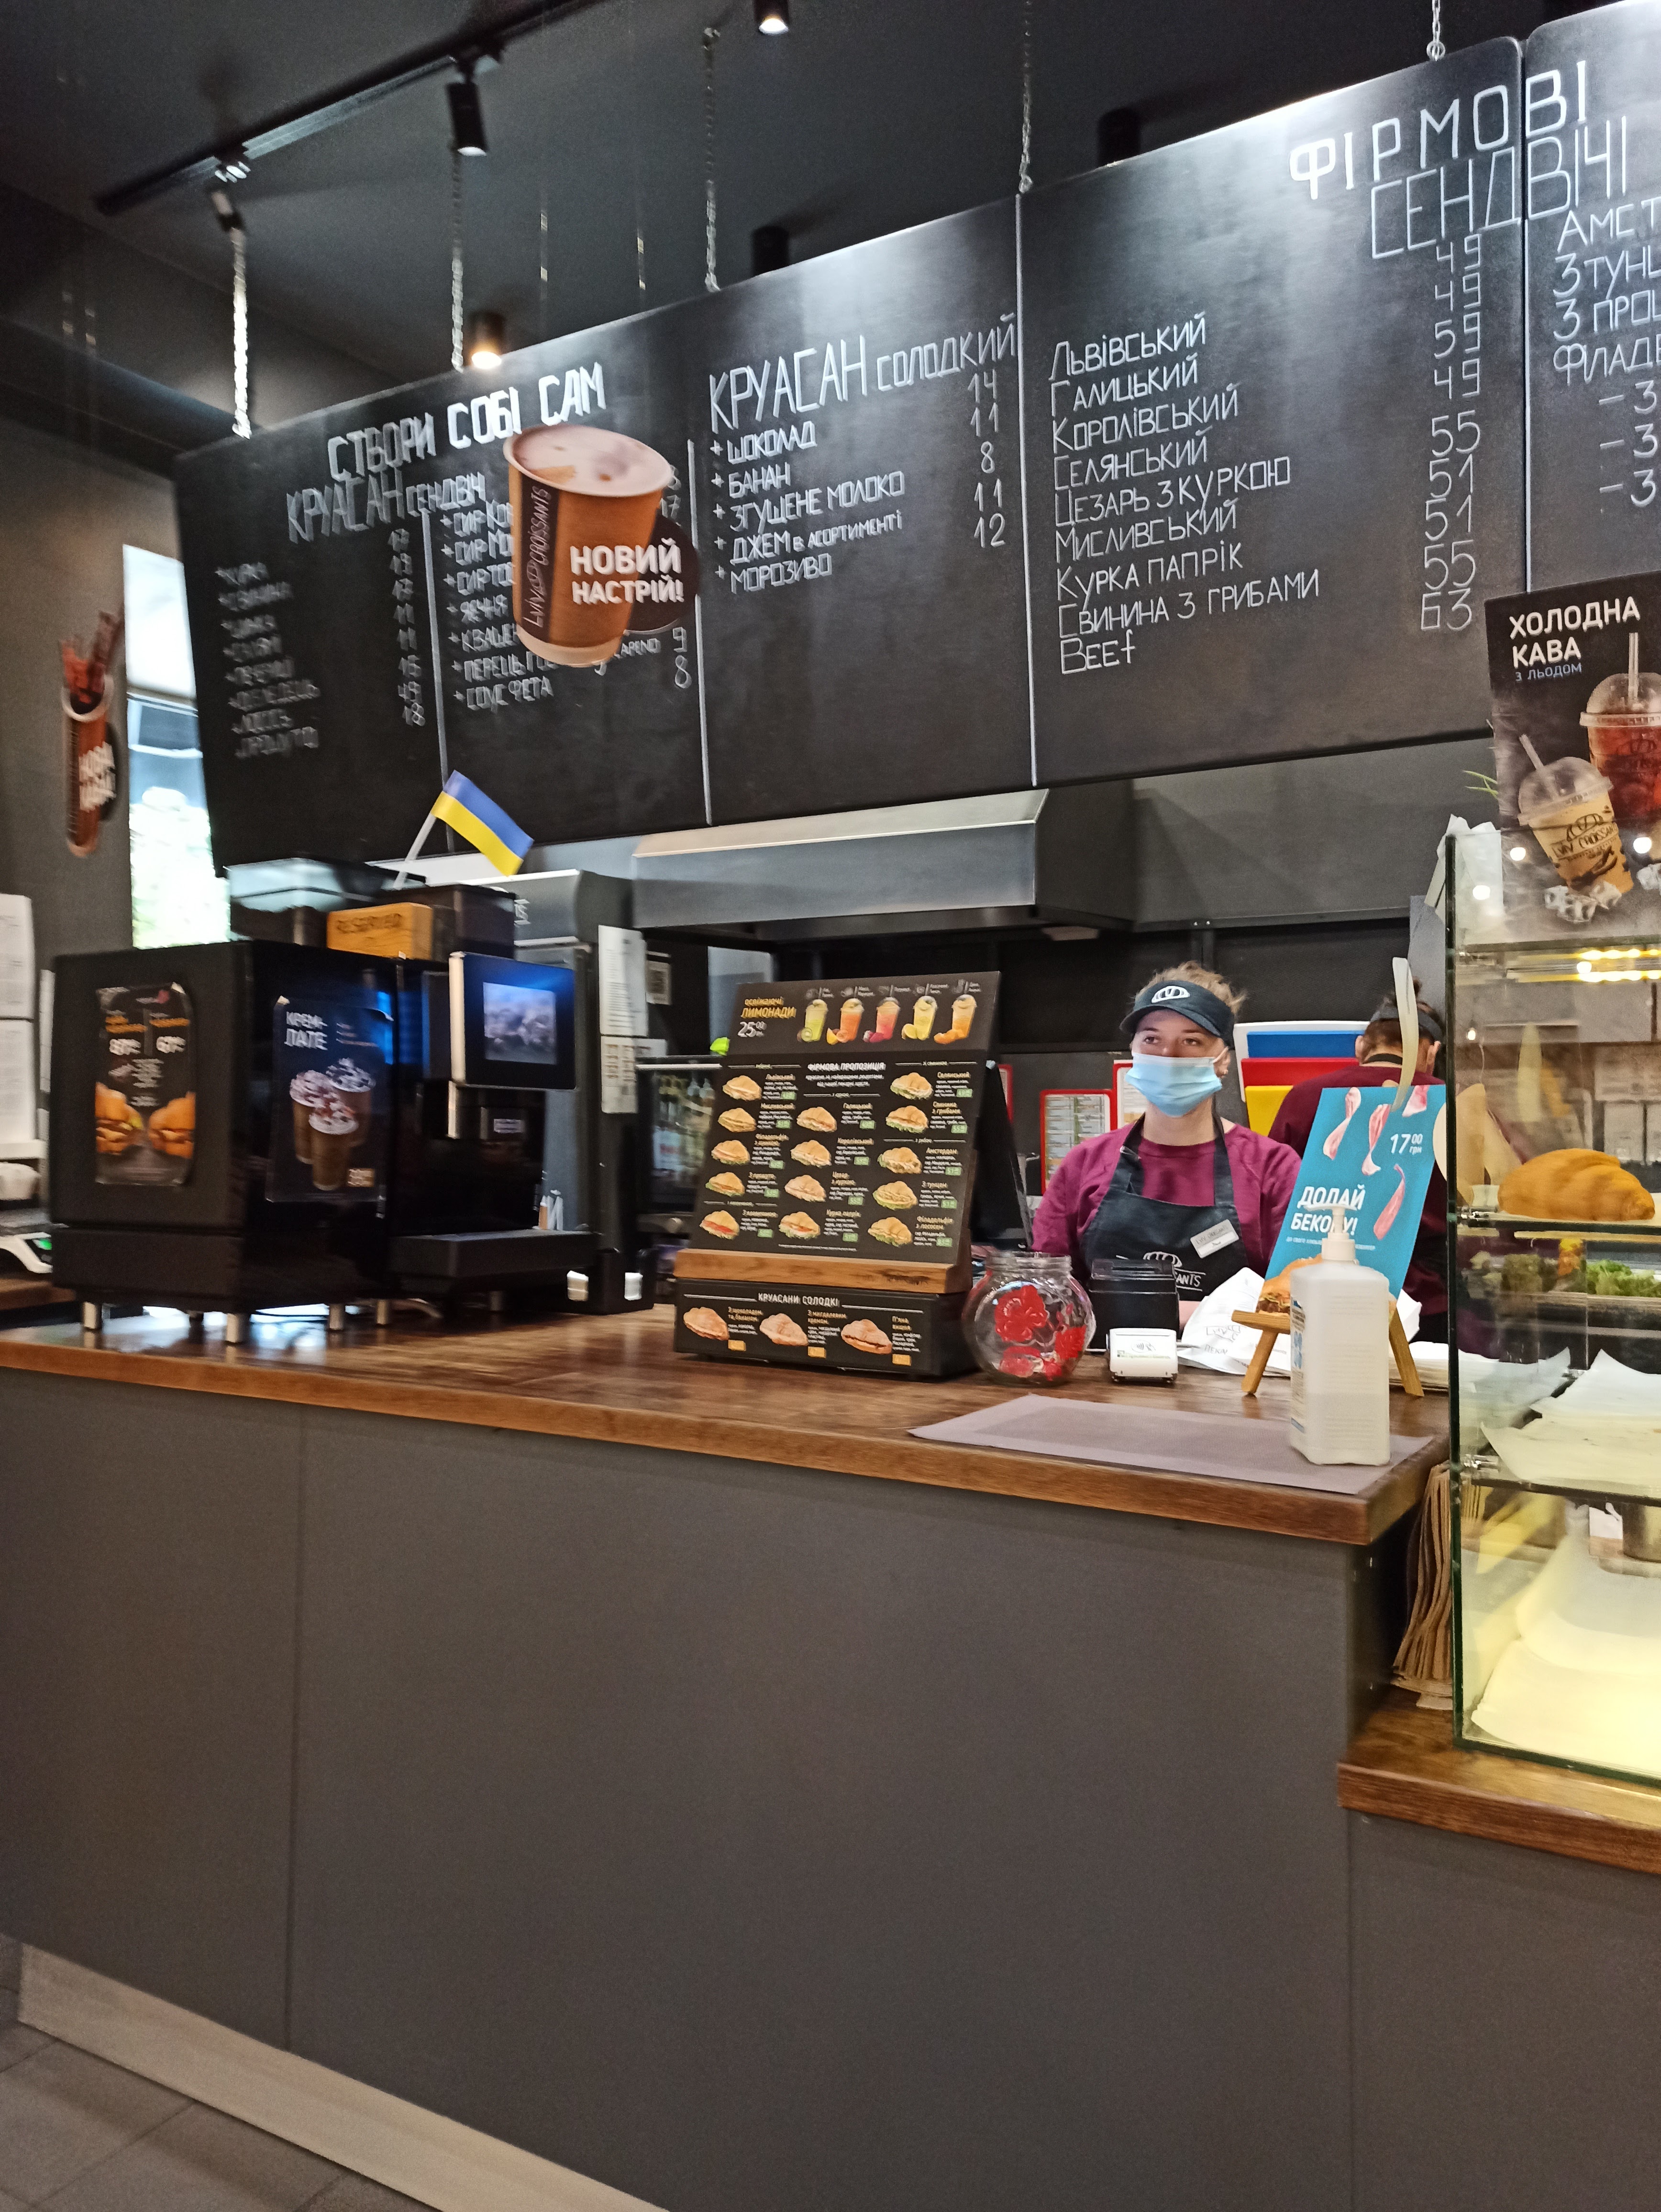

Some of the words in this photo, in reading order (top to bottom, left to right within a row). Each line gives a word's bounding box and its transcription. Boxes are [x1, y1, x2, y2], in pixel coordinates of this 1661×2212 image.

[1289, 60, 1586, 199] ФІРМОВІ
[1371, 116, 1627, 259] СЕНДВІЧІ
[1436, 233, 1481, 273] 49
[1435, 272, 1481, 311] 49
[1434, 311, 1480, 359] 59
[709, 334, 867, 434] КРУАСАН
[967, 369, 997, 403] 14
[1434, 358, 1480, 399] 49
[328, 412, 436, 482] СТВОРИ
[447, 387, 522, 449] СОБІ
[539, 362, 606, 426] САМ
[970, 402, 999, 436] 11
[1432, 409, 1481, 457] 55
[727, 420, 817, 464] ШОКОЛАД
[981, 442, 995, 473] 8
[729, 462, 791, 498] БАНАН
[828, 470, 905, 510] МОЛОКО
[974, 479, 1002, 511] 11
[1429, 454, 1473, 499] 51
[287, 467, 405, 544] КРУАСАН
[1425, 495, 1472, 541] 51
[730, 531, 791, 564] ДЖЕМ
[974, 513, 1005, 548] 12
[570, 538, 682, 575] НОВИЙ
[731, 553, 832, 594] МОРОЗИВО
[1425, 540, 1475, 590] 55
[572, 575, 685, 604] НАСТРІЙ!
[1509, 597, 1640, 640] ХОЛОДНА
[1513, 637, 1582, 668] КАВА
[1528, 663, 1582, 680] ЛЬОДОМ
[741, 1006, 797, 1018] ЛИМОНАДИ
[808, 1063, 841, 1072] ФІРМОВА
[841, 1062, 886, 1072] ПРОПОЗИЦІЯ
[1390, 1134, 1410, 1155] 17
[1297, 1184, 1366, 1210] ДОДАЙ
[1291, 1213, 1358, 1235] БЕКОУ!
[758, 1293, 801, 1305] КРУАСАНИ
[802, 1296, 840, 1307] СОЛОДКІ
